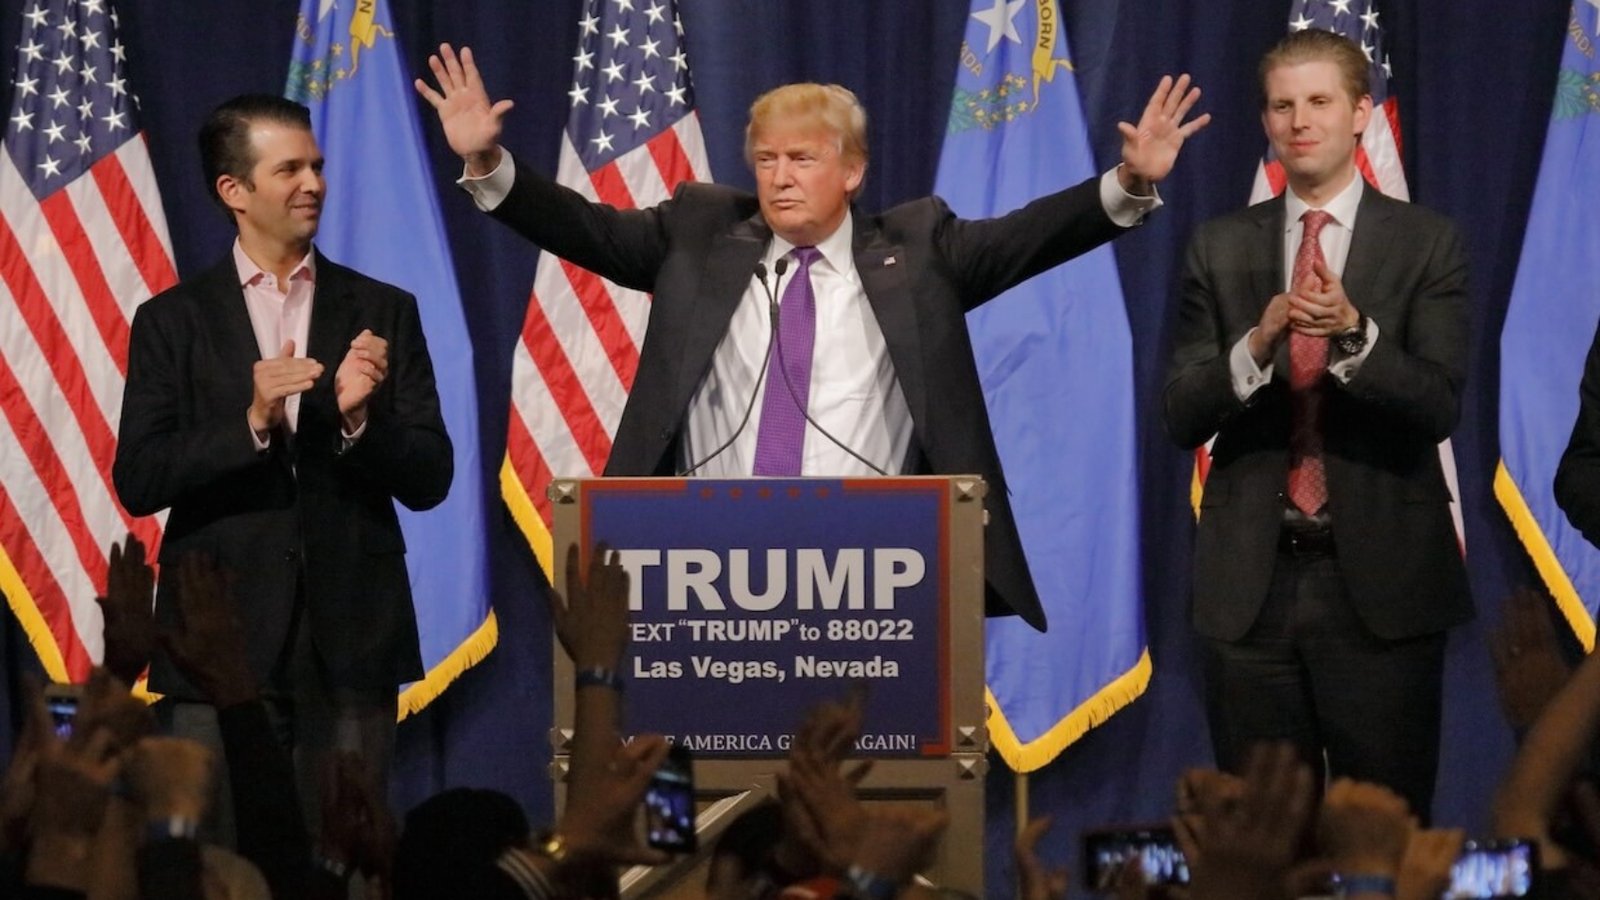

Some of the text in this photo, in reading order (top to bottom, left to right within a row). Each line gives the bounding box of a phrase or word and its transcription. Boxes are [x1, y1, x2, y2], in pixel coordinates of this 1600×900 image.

[604, 548, 925, 611] TRUMP
[629, 623, 675, 642] EXT
[799, 624, 821, 641] to
[827, 618, 914, 641] 88022
[634, 655, 899, 684] Las Vegas, Nevada
[683, 734, 773, 750] AMERICA
